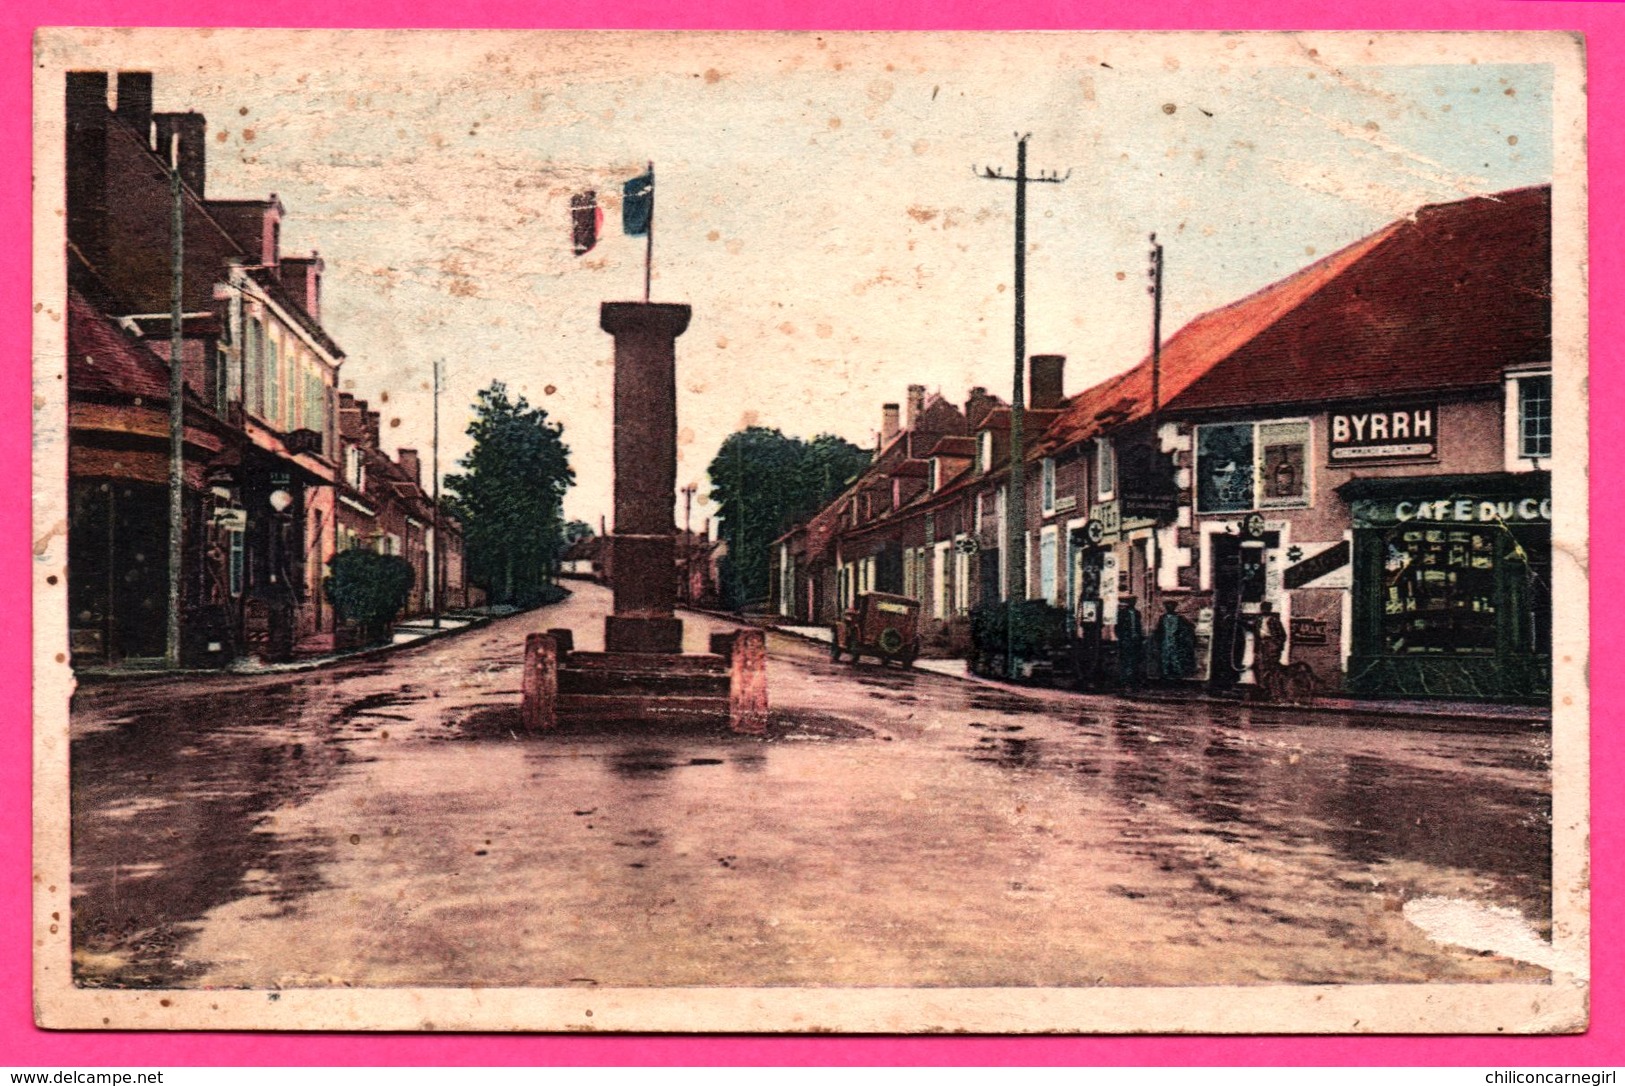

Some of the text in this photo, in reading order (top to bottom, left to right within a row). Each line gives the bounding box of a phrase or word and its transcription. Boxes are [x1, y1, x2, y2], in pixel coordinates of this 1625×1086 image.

[1333, 410, 1431, 442] BYRRH
[1395, 500, 1473, 522] CAFE
[1479, 501, 1514, 522] DU
